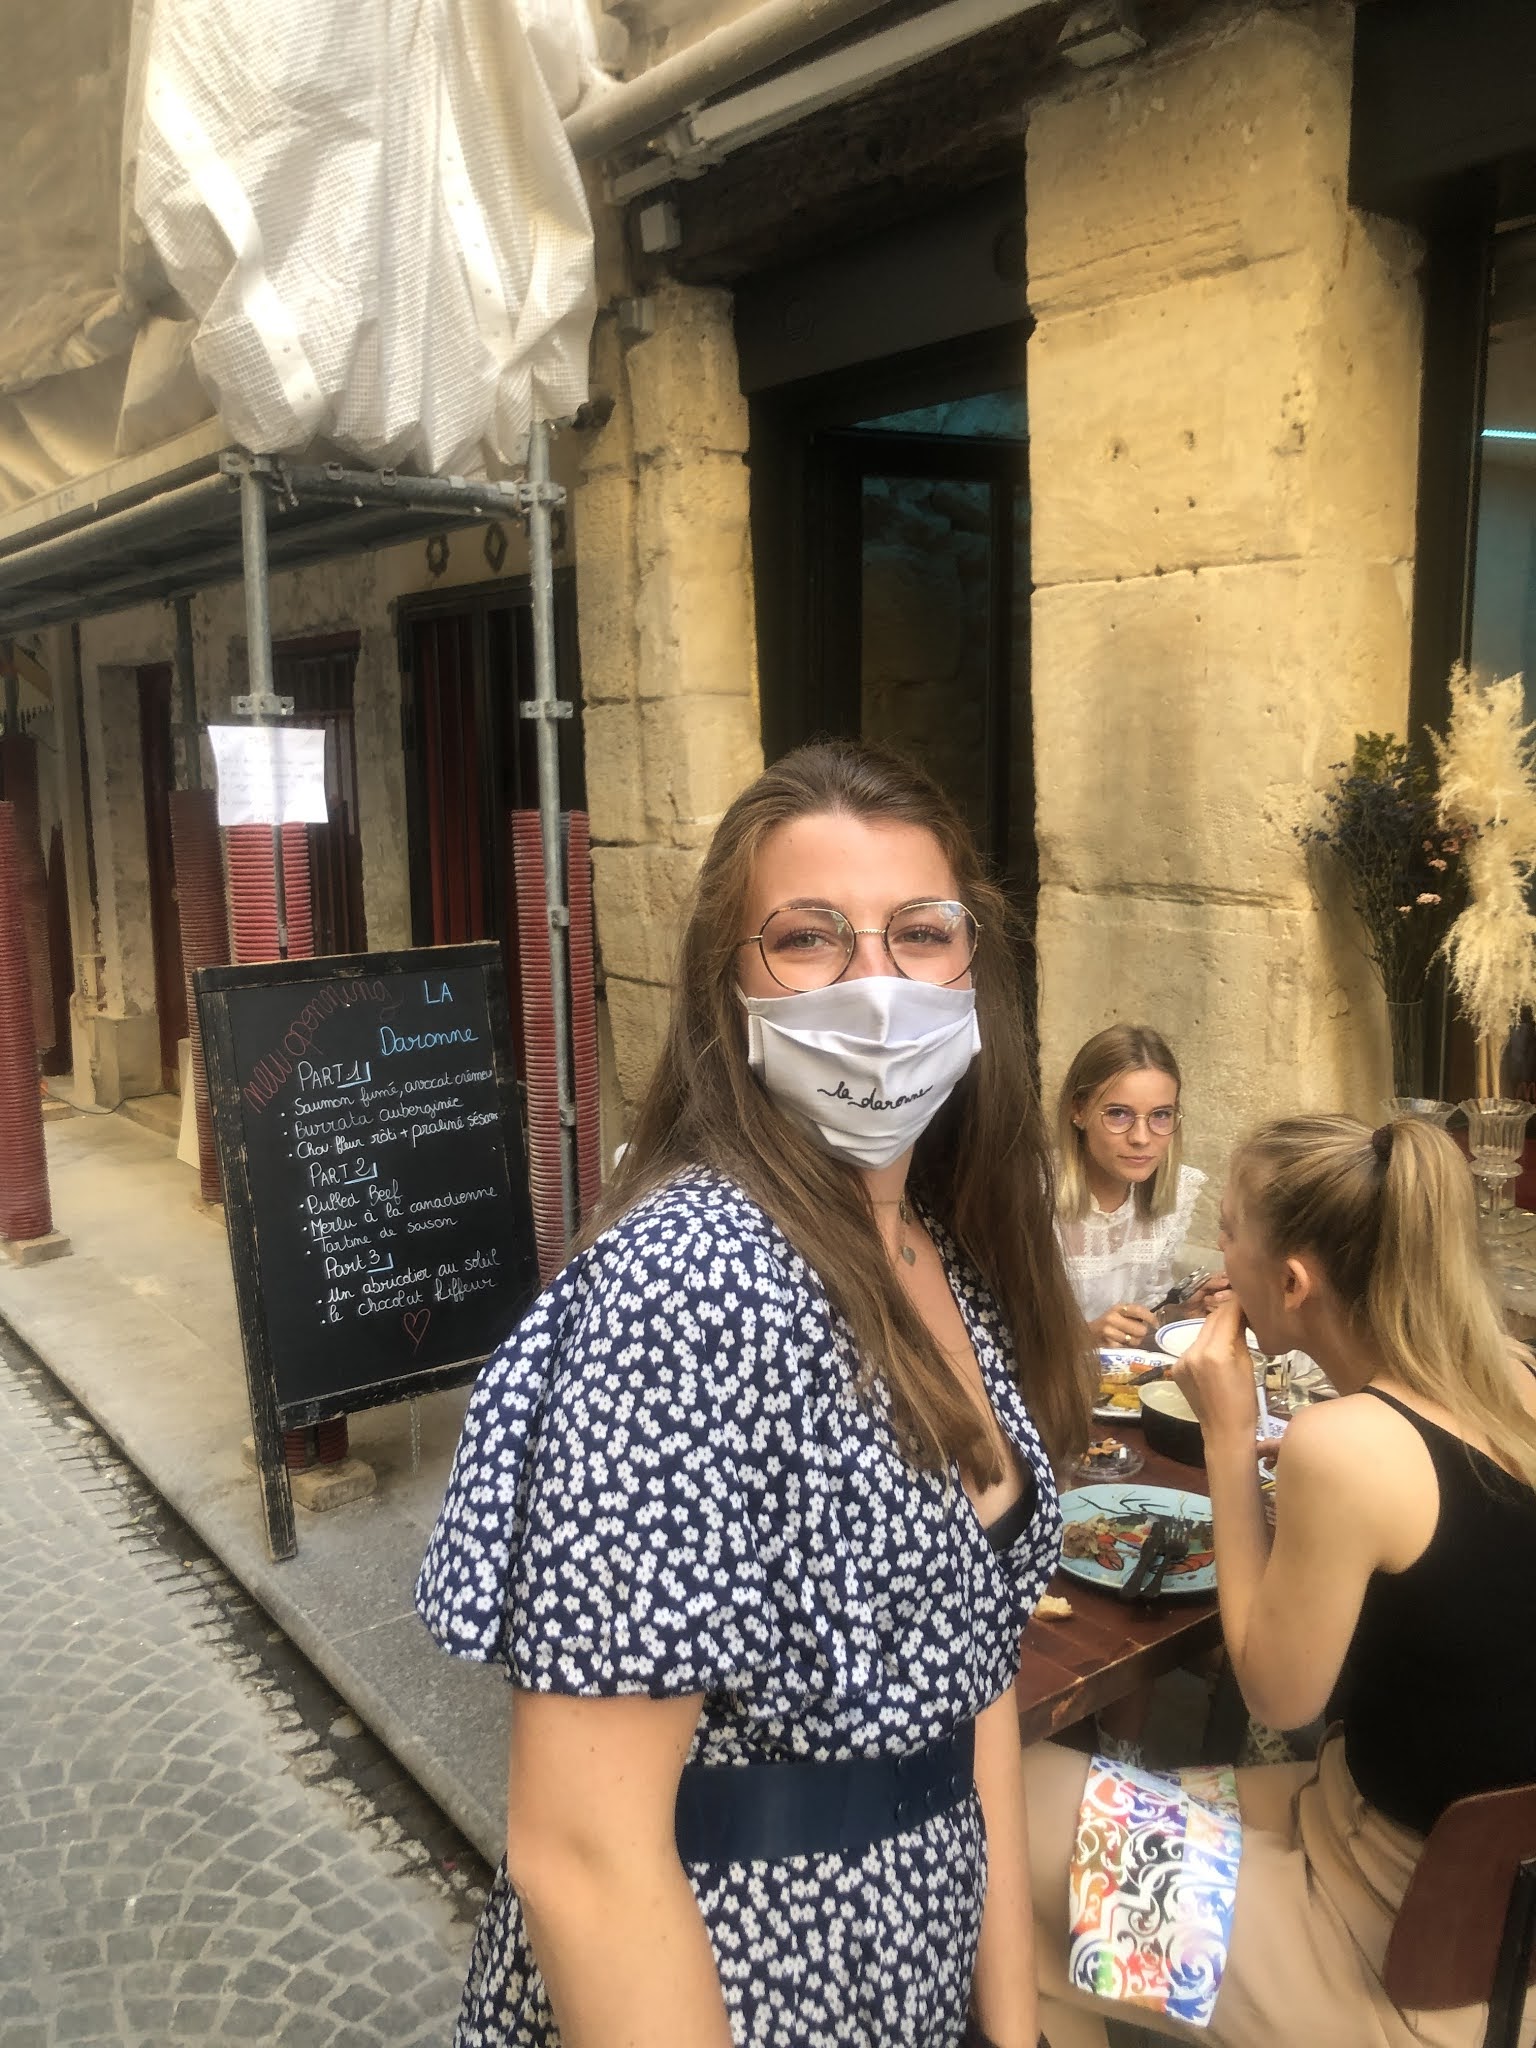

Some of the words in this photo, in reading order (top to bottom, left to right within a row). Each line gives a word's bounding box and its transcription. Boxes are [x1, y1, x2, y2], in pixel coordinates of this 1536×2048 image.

[424, 980, 454, 1004] LA
[380, 1026, 480, 1056] Daronne
[243, 1049, 293, 1114] new
[294, 1097, 355, 1116] Saumon
[404, 1072, 453, 1094] avocat
[847, 1085, 934, 1111] daronne
[295, 1110, 375, 1140] Burrata
[370, 1128, 398, 1145] rôti
[412, 1116, 466, 1149] praliné
[309, 1161, 349, 1188] PART
[355, 1157, 372, 1178] 2
[306, 1191, 361, 1215] Pulled
[368, 1178, 404, 1207] Beef
[310, 1216, 358, 1237] Merlu
[363, 1208, 379, 1223] à
[386, 1202, 404, 1219] la
[409, 1186, 498, 1214] canadienne
[313, 1234, 373, 1253] Tartine
[379, 1227, 398, 1240] de
[407, 1216, 459, 1234] saison
[325, 1256, 367, 1280] Part
[369, 1248, 382, 1266] 3
[362, 1266, 433, 1295] abricotier
[438, 1262, 460, 1278] au
[464, 1247, 503, 1272] soleil
[357, 1288, 424, 1317] chocolat
